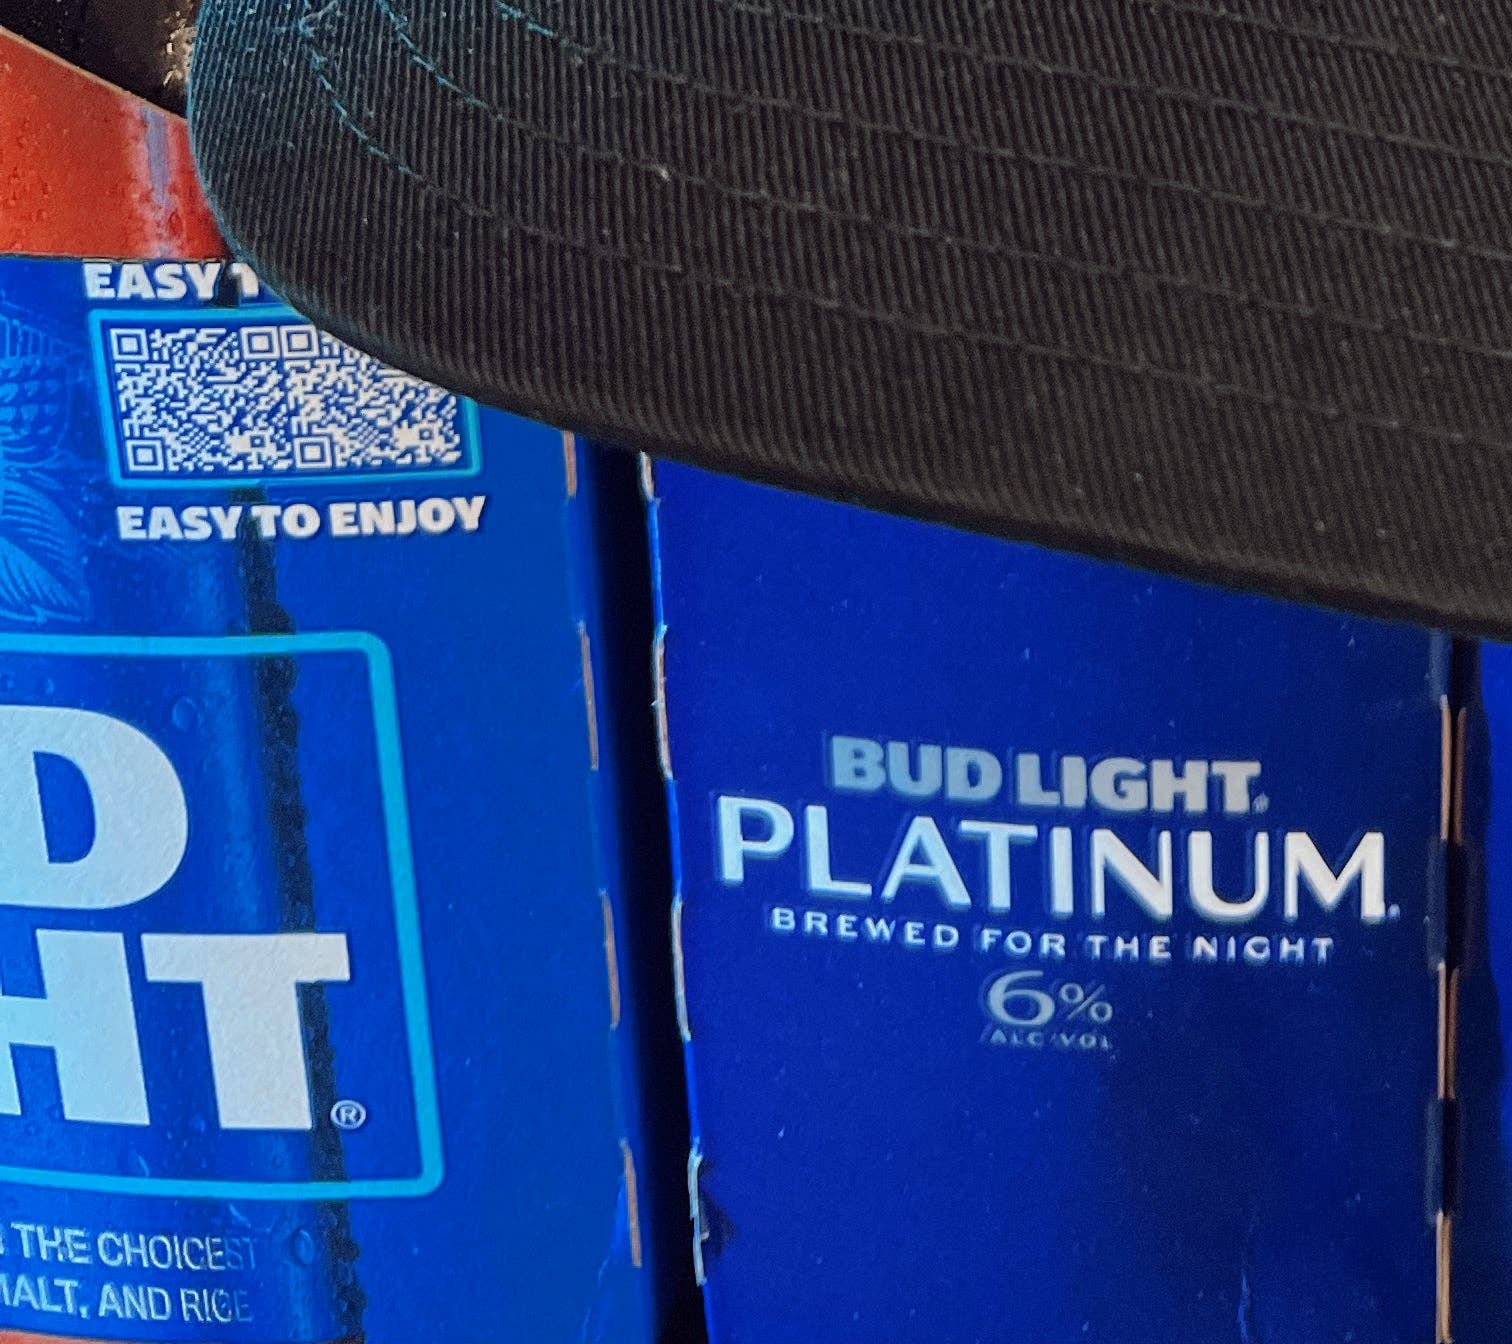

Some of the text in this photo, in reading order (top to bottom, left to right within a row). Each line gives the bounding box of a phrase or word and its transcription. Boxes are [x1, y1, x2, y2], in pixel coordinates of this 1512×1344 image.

[83, 262, 222, 300] EASY
[116, 495, 486, 541] EASY TO ENJOY
[830, 735, 1262, 813] BUD LIGHT
[715, 794, 1387, 923] PLATINUM
[771, 906, 1334, 963] BREWED FOR THE NIGHT
[988, 970, 1113, 1025] 6%
[11, 1222, 92, 1264] THE
[97, 1231, 256, 1271] CHOICEST
[98, 1282, 171, 1321] AND
[180, 1288, 254, 1322] RICE
